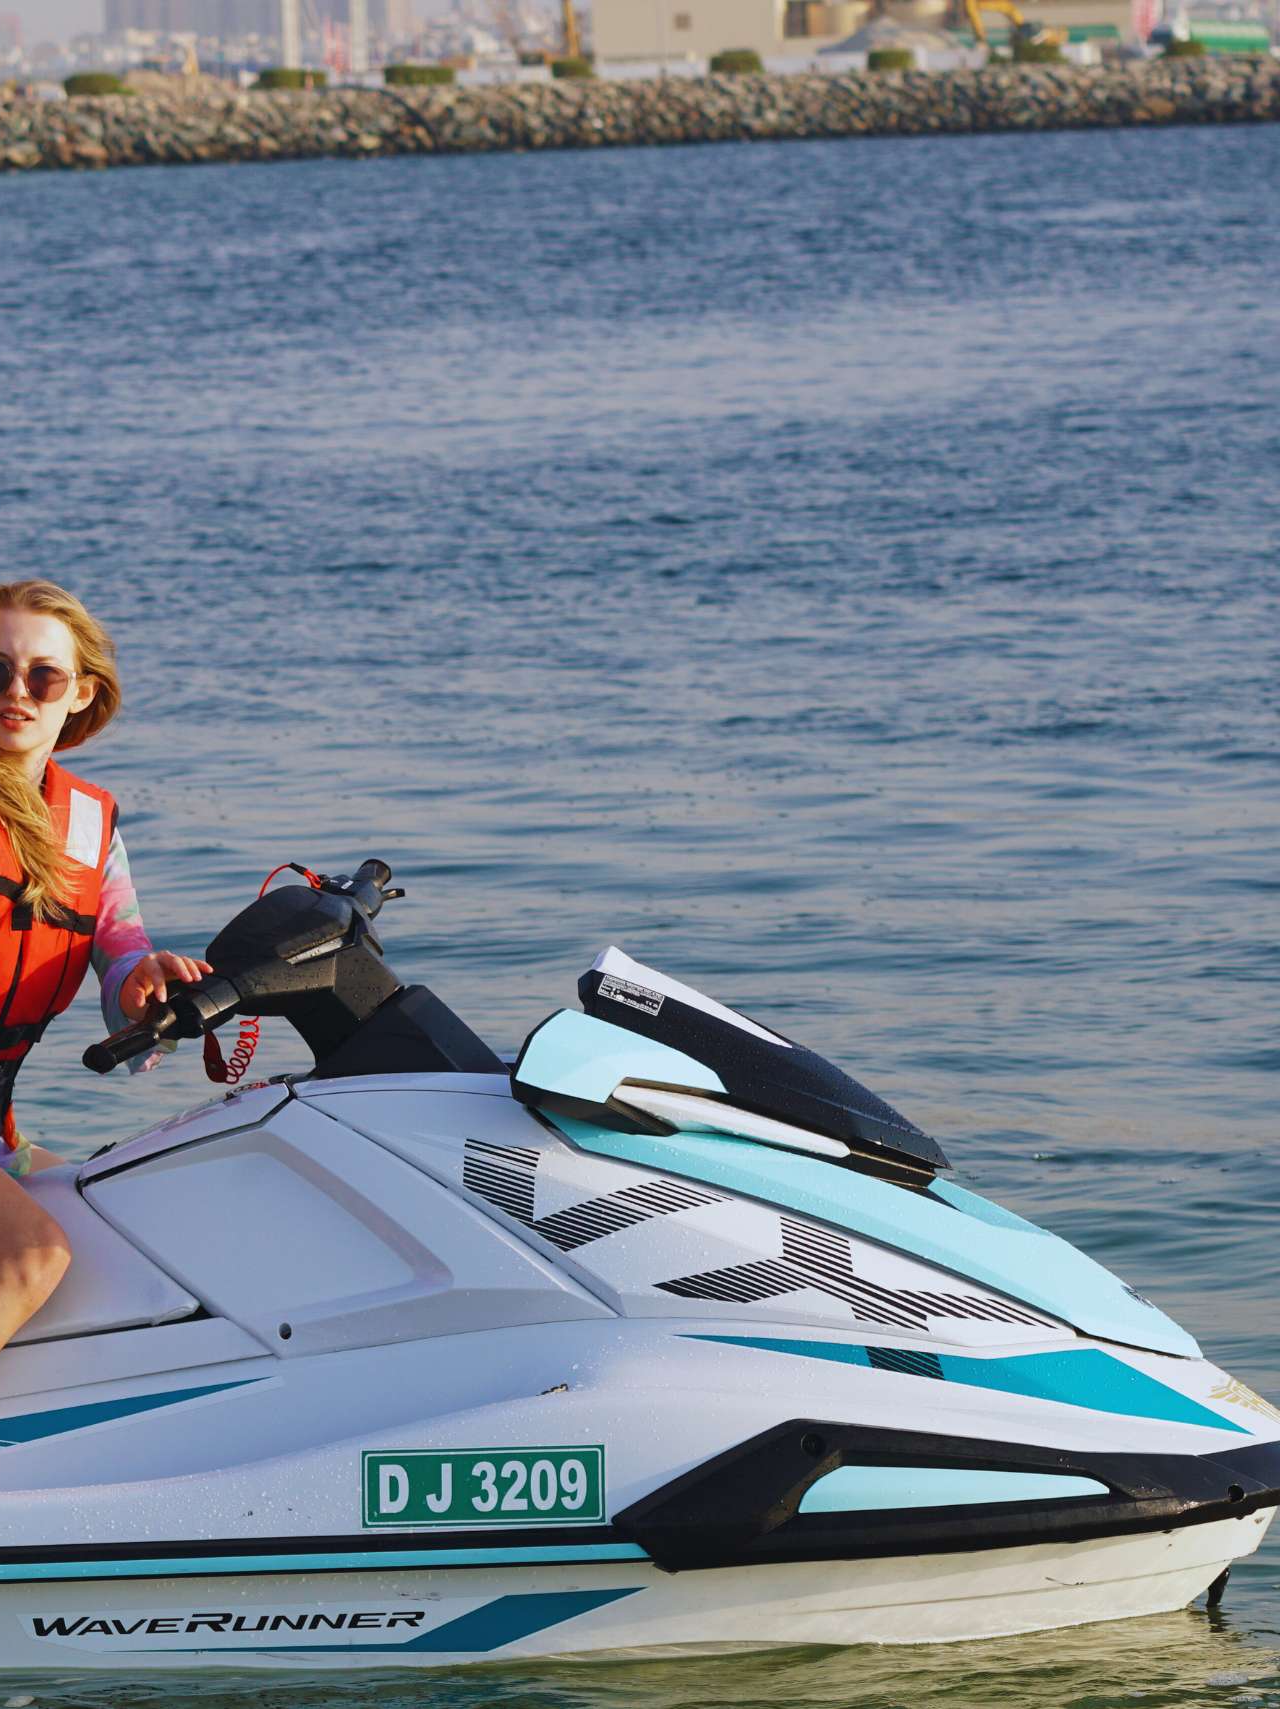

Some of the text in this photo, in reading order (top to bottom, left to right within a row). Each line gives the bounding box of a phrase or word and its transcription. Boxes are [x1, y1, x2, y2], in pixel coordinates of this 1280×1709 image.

[378, 1459, 588, 1515] D J 3209
[31, 1611, 427, 1638] WAVERUNNER
